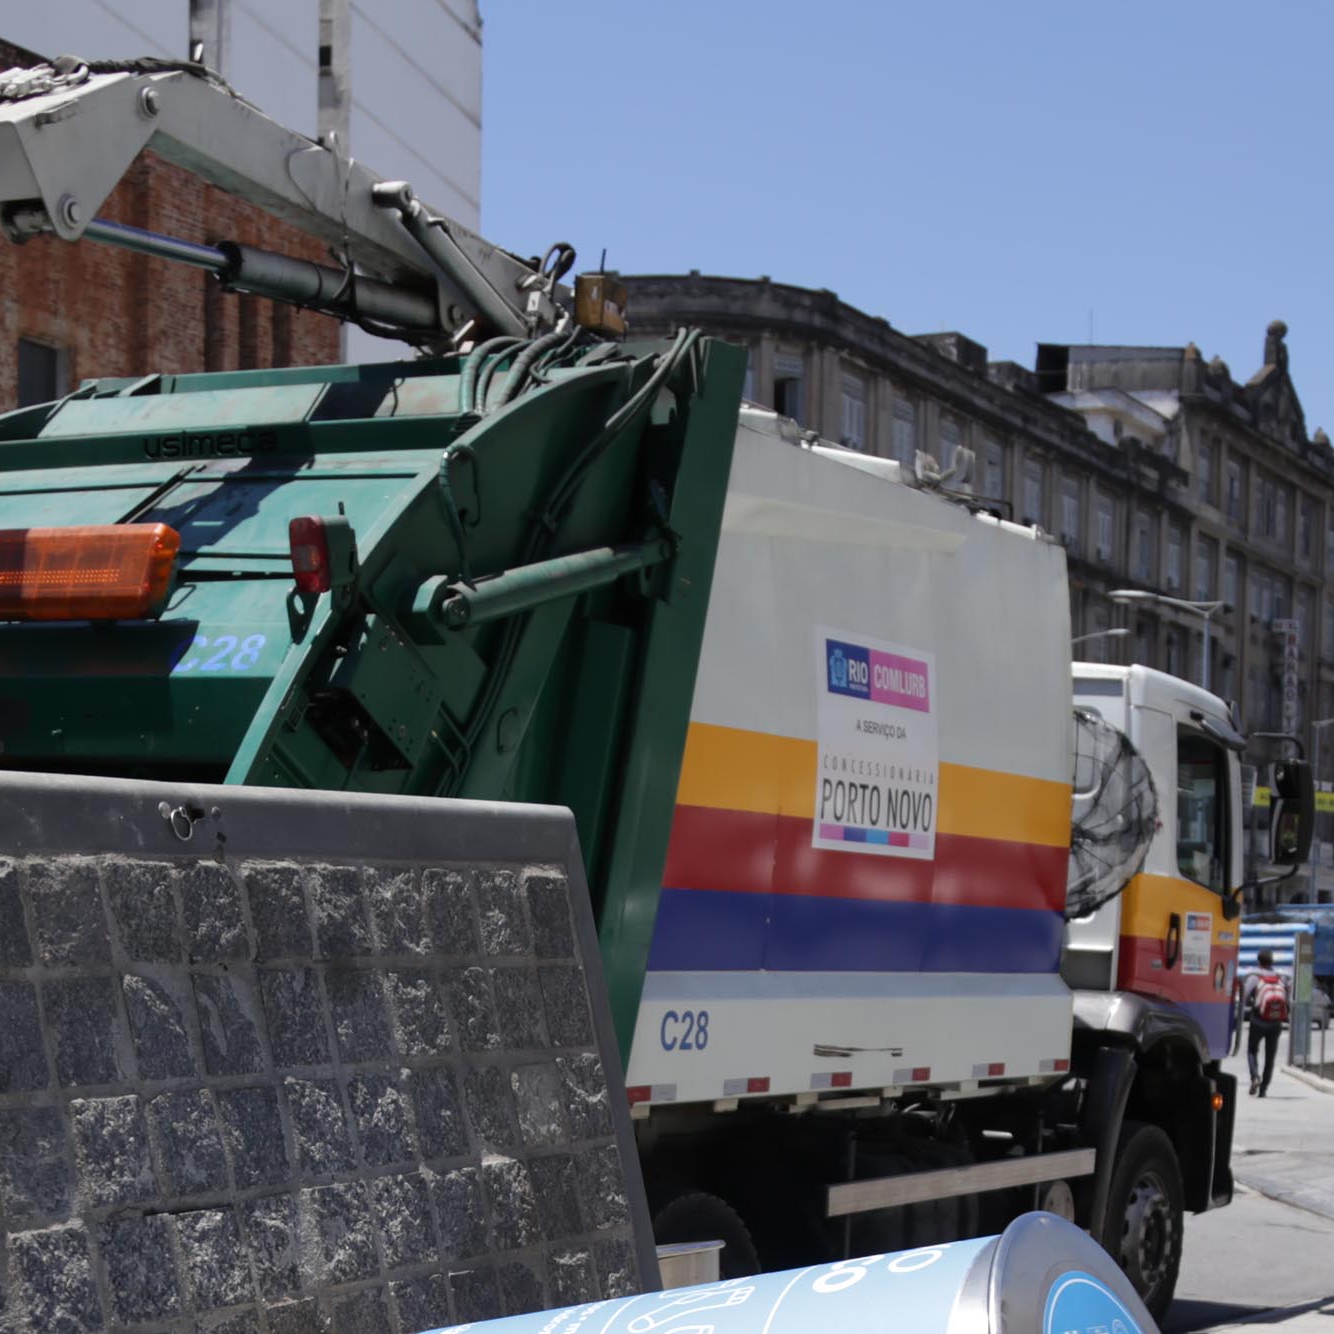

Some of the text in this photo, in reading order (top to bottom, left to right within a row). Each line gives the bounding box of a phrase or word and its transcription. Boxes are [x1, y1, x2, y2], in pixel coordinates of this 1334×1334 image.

[143, 430, 276, 459] usimeca
[170, 633, 267, 672] C28
[848, 658, 869, 685] RIO
[874, 663, 926, 698] COMLURB
[855, 718, 907, 740] A SERVIÇO DA
[820, 777, 933, 833] PORTO NOVO
[660, 1009, 710, 1052] C28
